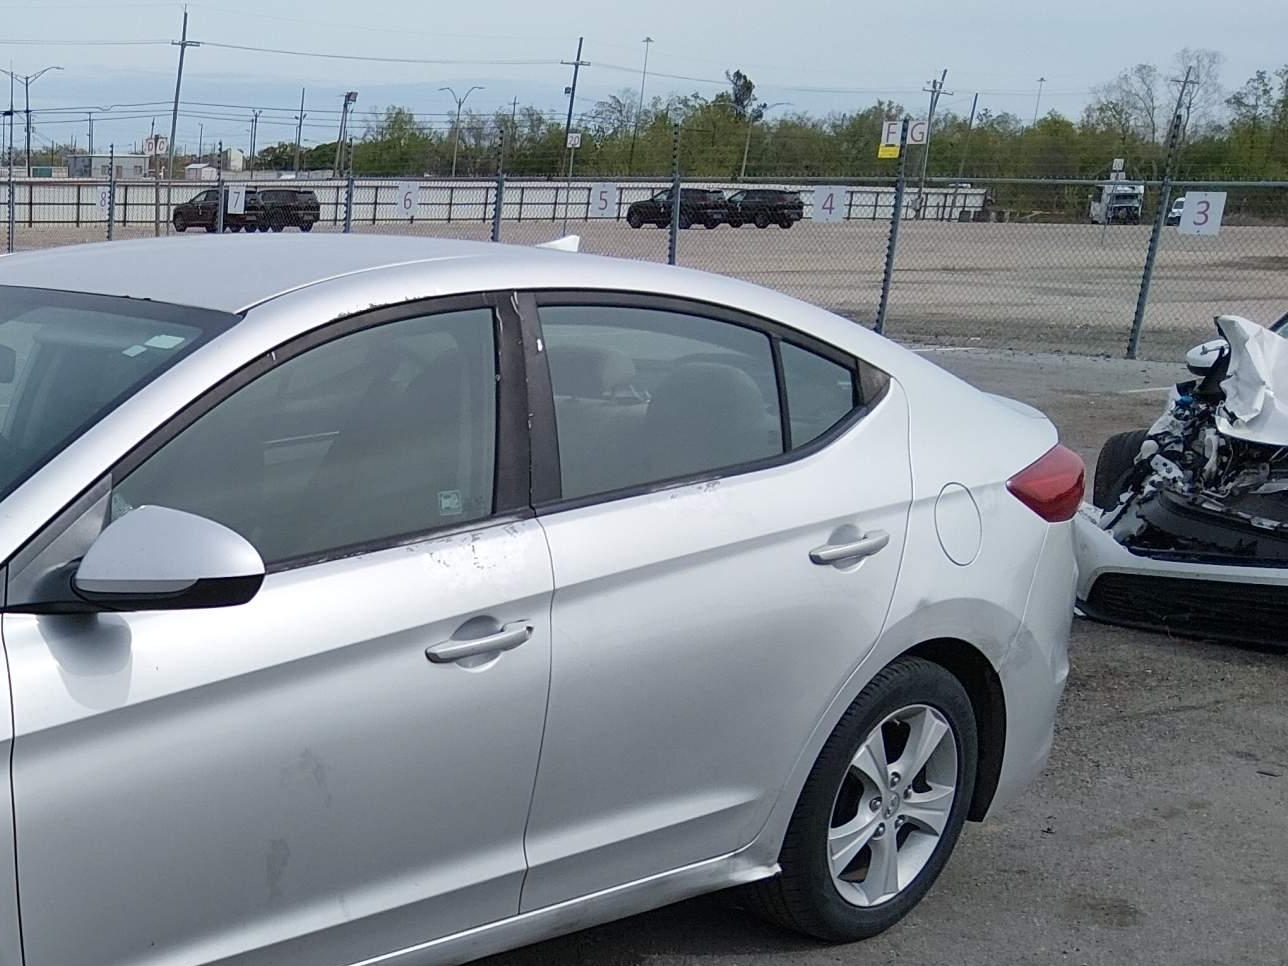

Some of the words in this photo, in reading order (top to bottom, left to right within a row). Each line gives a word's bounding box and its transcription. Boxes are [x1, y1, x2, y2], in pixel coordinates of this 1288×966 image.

[886, 122, 898, 143] F
[910, 122, 925, 143] G
[100, 191, 107, 207] 8
[233, 191, 241, 208] 7
[403, 191, 412, 210] 6
[598, 190, 609, 211] 5
[822, 192, 835, 215] 4
[1193, 200, 1211, 226] 3
